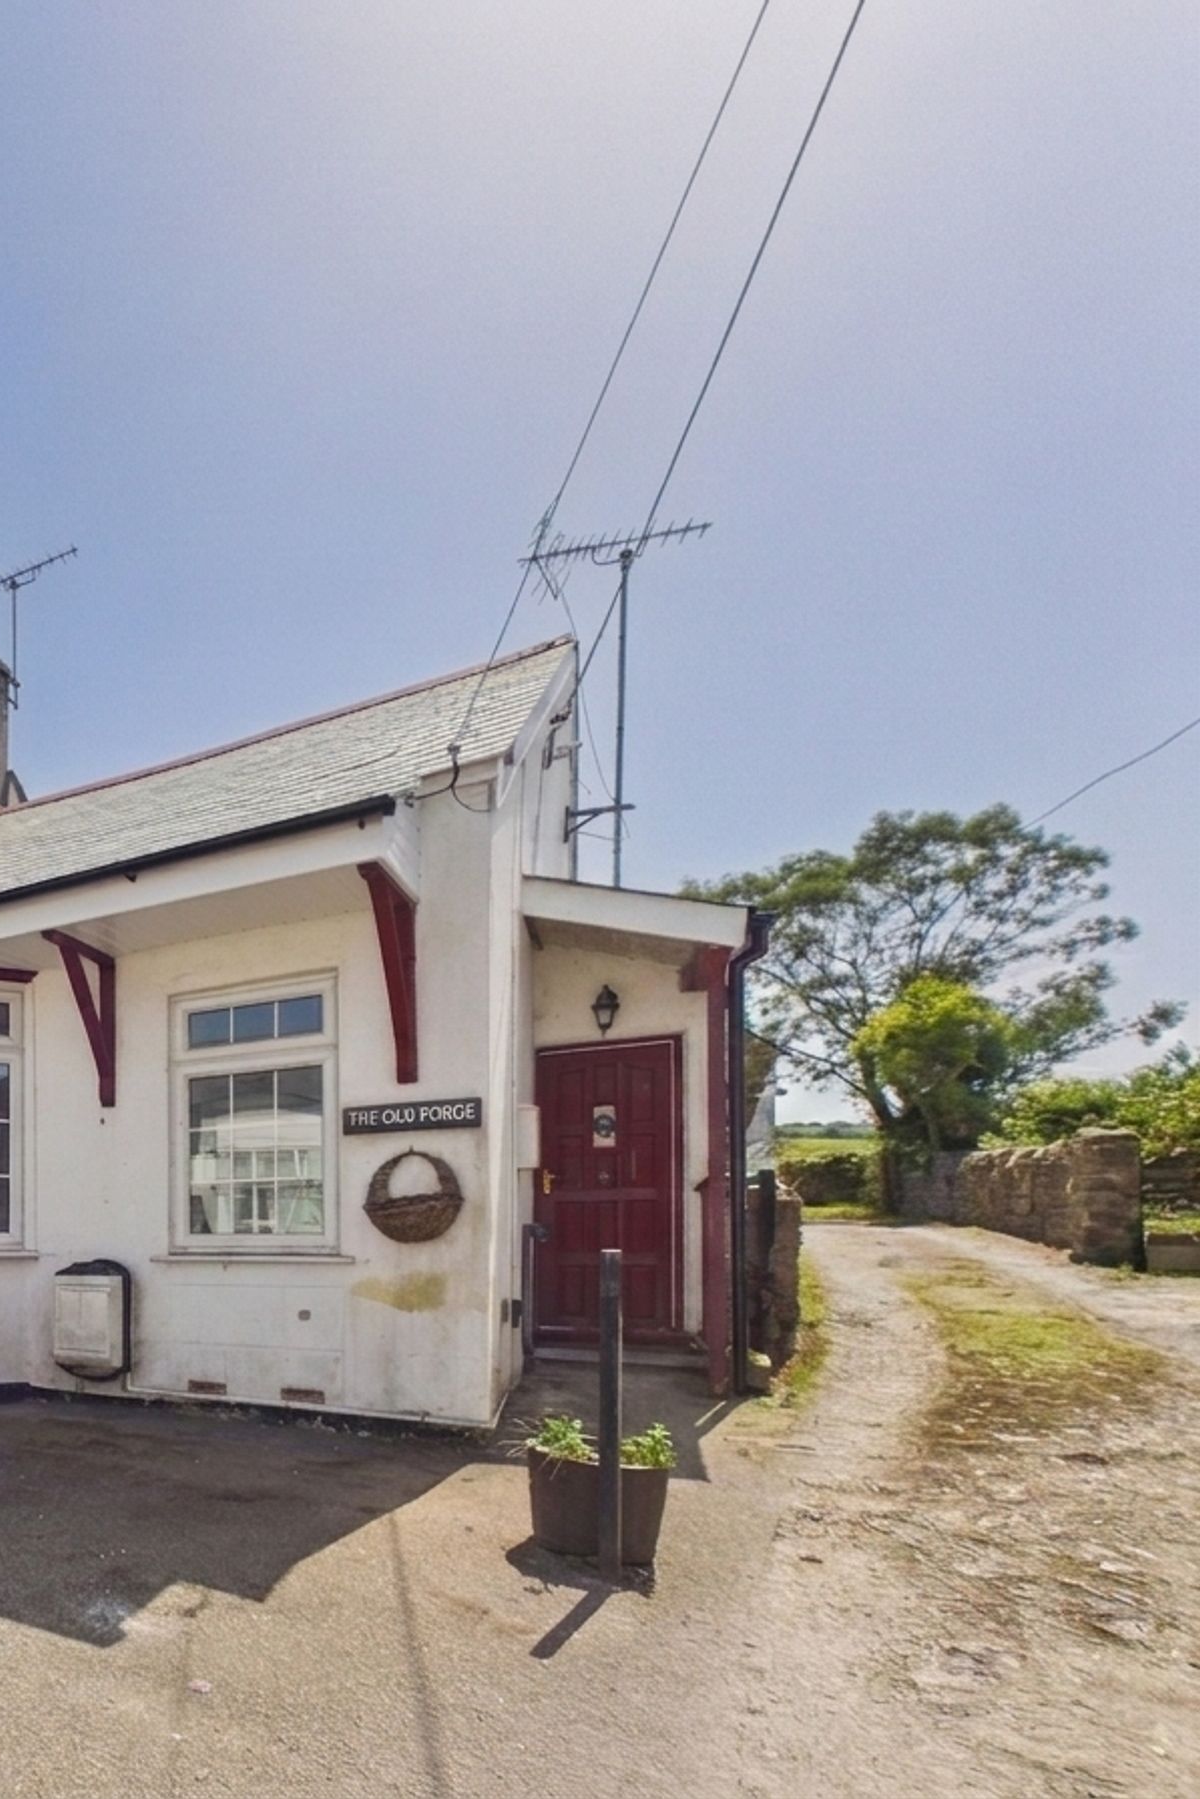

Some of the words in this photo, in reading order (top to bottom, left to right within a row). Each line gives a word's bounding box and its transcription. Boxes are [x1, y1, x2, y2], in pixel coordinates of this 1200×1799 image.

[348, 1110, 379, 1126] THE
[382, 1107, 415, 1124] OLD
[419, 1102, 476, 1122] FORGE
